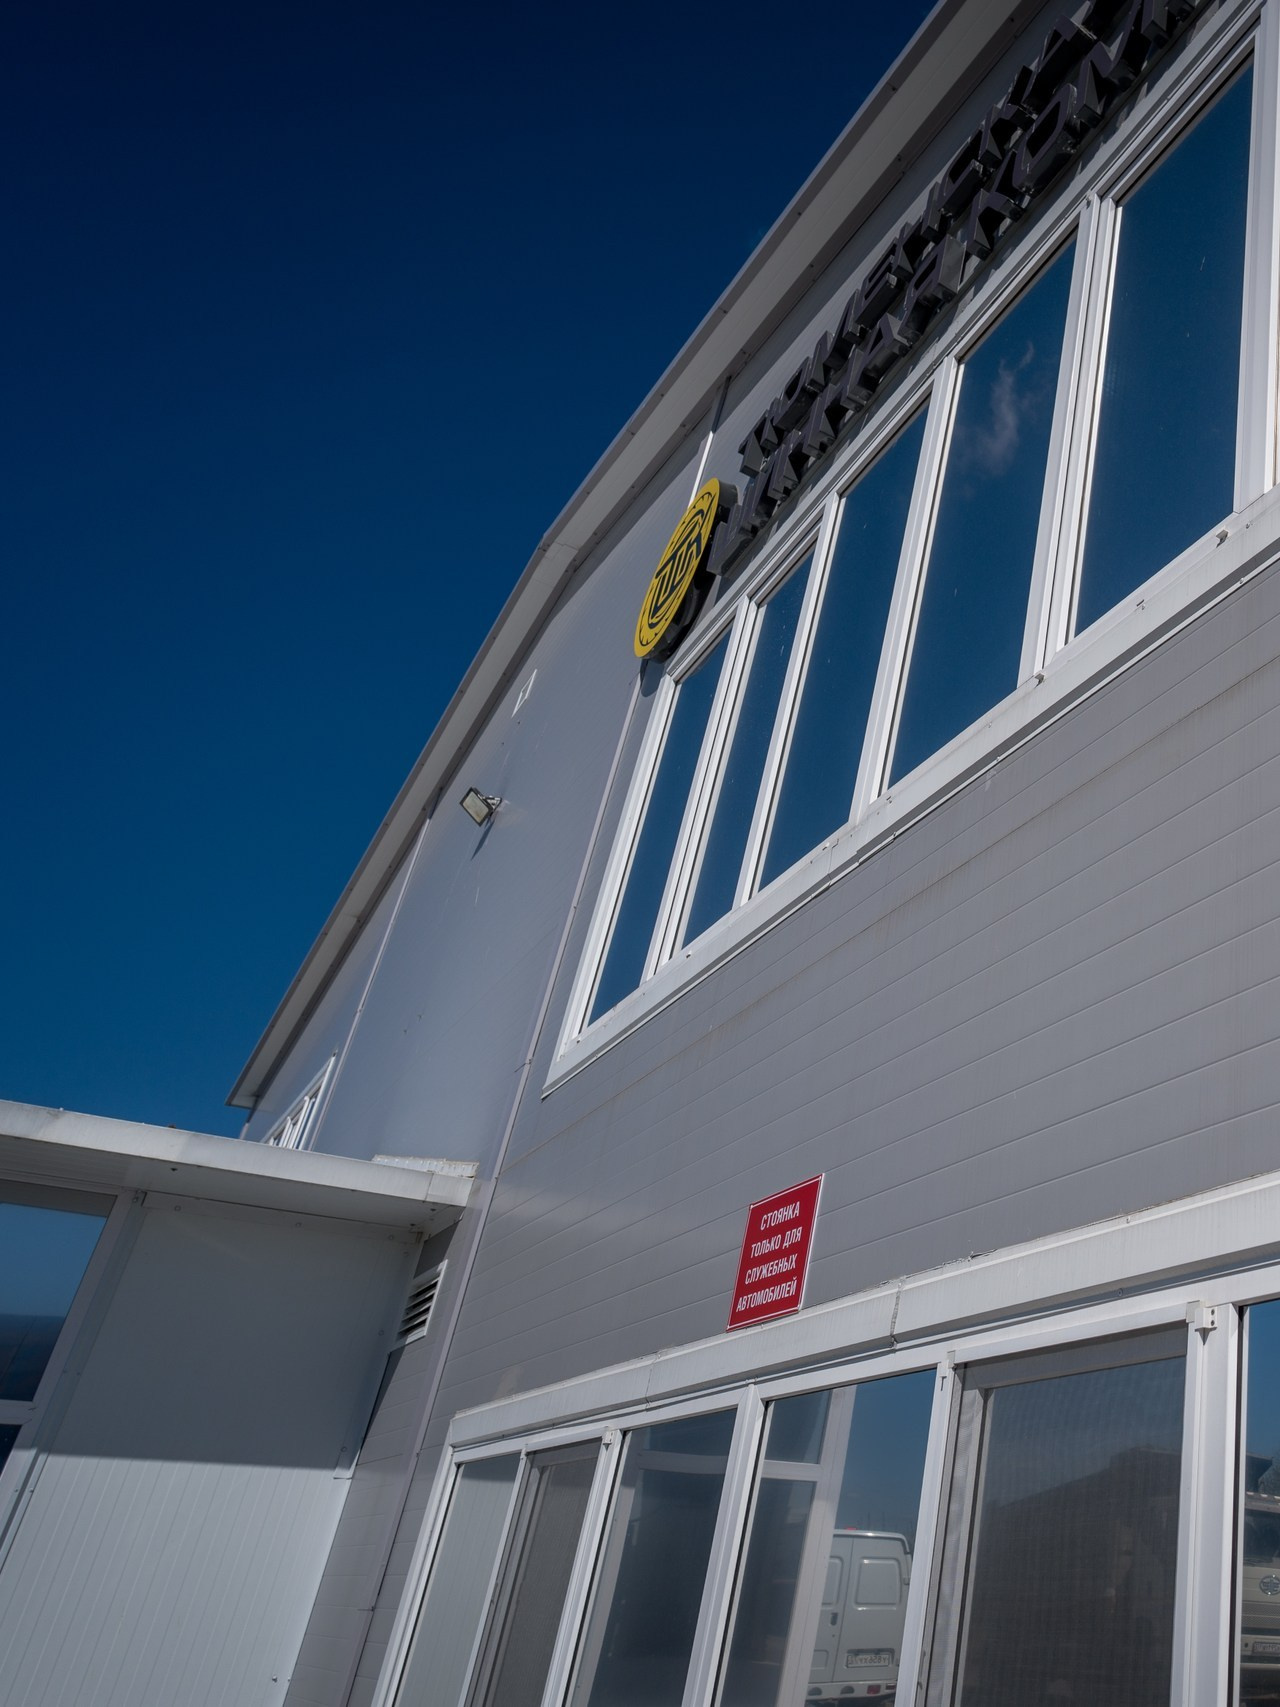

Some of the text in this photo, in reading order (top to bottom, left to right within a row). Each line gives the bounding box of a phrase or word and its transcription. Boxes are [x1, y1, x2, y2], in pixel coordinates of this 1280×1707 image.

[760, 1201, 800, 1230] СТОЯНКА
[751, 1227, 803, 1258] ТОЛЬКО ДЛЯ
[745, 1254, 798, 1284] СЛУЖЕБНЫХ
[737, 1277, 798, 1311] АВТОМОБИЛЕЙ
